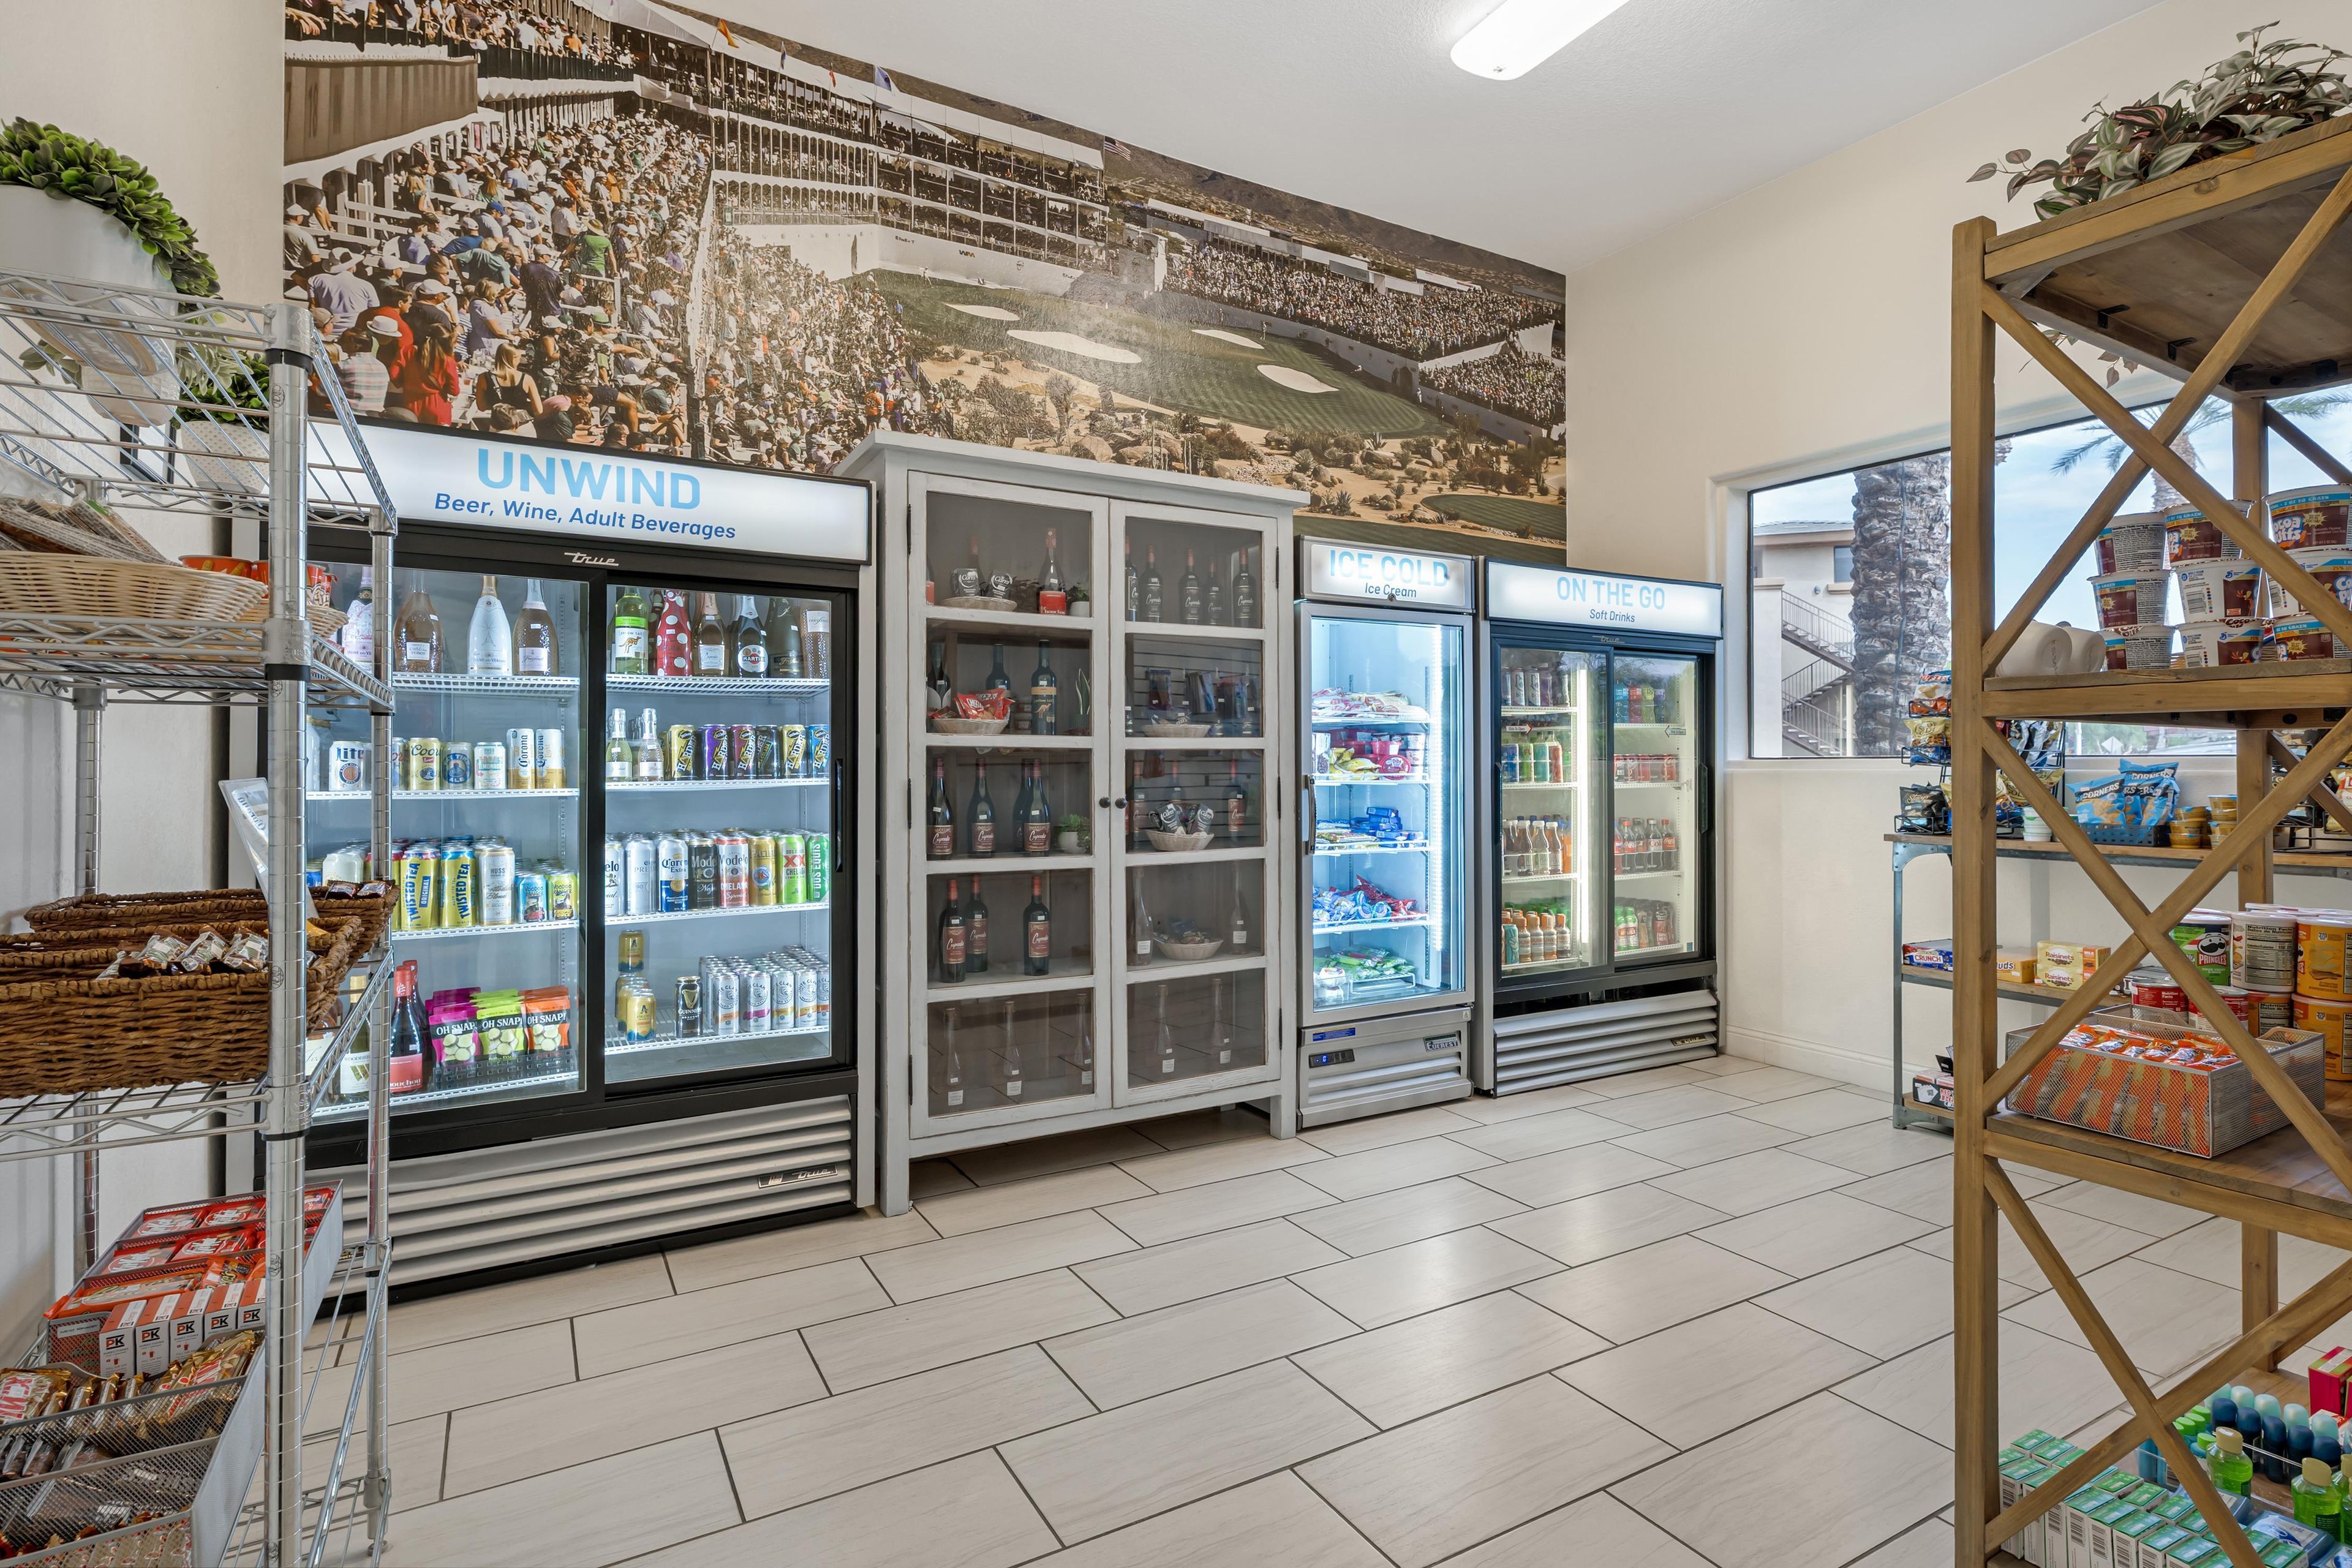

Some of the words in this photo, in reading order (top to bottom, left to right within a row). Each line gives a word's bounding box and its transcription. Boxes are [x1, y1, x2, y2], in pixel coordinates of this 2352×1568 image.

[478, 448, 701, 510] UNWIND
[434, 492, 493, 518] Beer,
[503, 499, 562, 524] Wine,
[569, 507, 625, 529] Adult
[631, 513, 737, 540] Beverages
[2273, 517, 2301, 532] ocoa
[2276, 528, 2301, 543] uffs
[1329, 549, 1373, 581] ICE
[1380, 554, 1449, 587] COLD
[1365, 582, 1381, 595] Ice
[1382, 584, 1417, 599] Cream
[1556, 576, 1588, 603] ON
[1591, 579, 1634, 607] THE
[1638, 586, 1666, 611] GO
[1589, 609, 1607, 621] Soft
[1608, 610, 1635, 623] Drinks
[518, 734, 529, 768] Corona
[662, 858, 688, 869] Coron
[812, 843, 821, 871] EQUIS
[405, 863, 421, 880] TEA
[457, 863, 471, 880] TEA
[813, 872, 821, 889] DOS
[420, 877, 430, 905] ORIGINAL
[405, 881, 421, 922] TWISTED
[456, 880, 471, 919] TWISTED
[1915, 954, 1941, 963] CRUNCH
[2045, 951, 2075, 961] Raisinets
[2199, 954, 2226, 966] PRINGLES
[1997, 961, 2015, 970] uds
[2045, 972, 2074, 982] Raisinets
[481, 1019, 496, 1030] OH
[527, 1015, 540, 1025] OH
[540, 1012, 567, 1023] SNAP!
[437, 1025, 450, 1036] OH
[211, 1317, 228, 1327] PK
[243, 1311, 260, 1321] PK
[141, 1329, 160, 1341] PK
[177, 1322, 195, 1334] PK
[106, 1336, 124, 1348] PK
